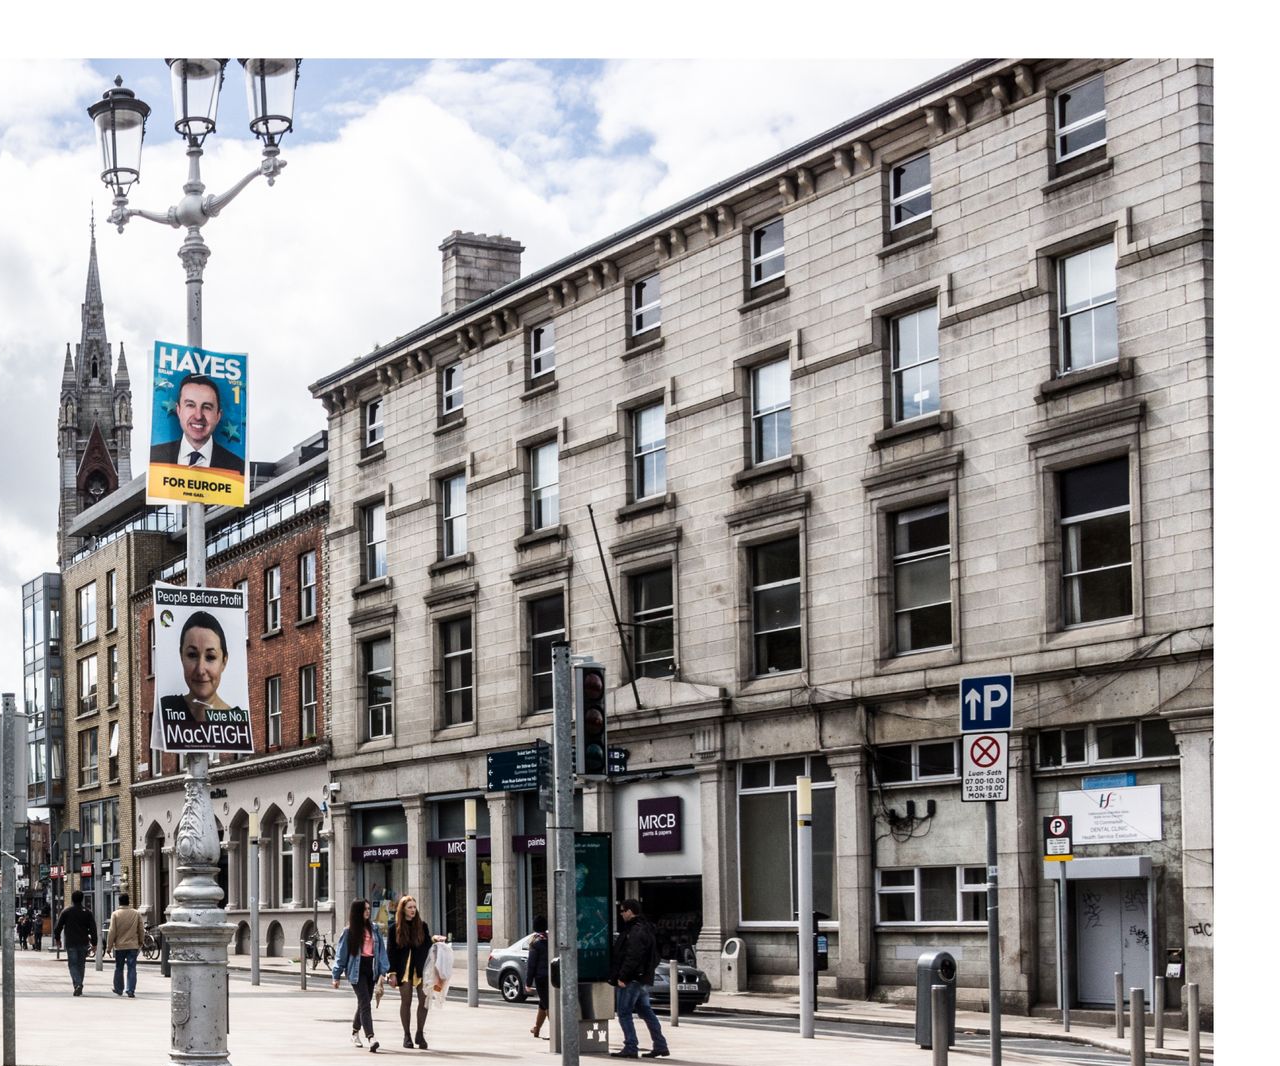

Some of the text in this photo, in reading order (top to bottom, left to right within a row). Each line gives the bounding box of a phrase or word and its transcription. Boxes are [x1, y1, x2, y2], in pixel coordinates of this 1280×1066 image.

[158, 346, 241, 380] HAYES
[232, 386, 240, 404] 1
[163, 476, 232, 493] FOR EUROPE
[157, 590, 242, 606] People Before Profit
[984, 684, 1008, 721] P
[165, 708, 248, 722] Tina Vote No.1
[166, 724, 250, 744] MacVEIGH
[639, 814, 676, 830] MRCB
[448, 842, 466, 853] MRC
[527, 838, 545, 848] paints
[363, 848, 377, 858] paints
[384, 847, 398, 857] papers
